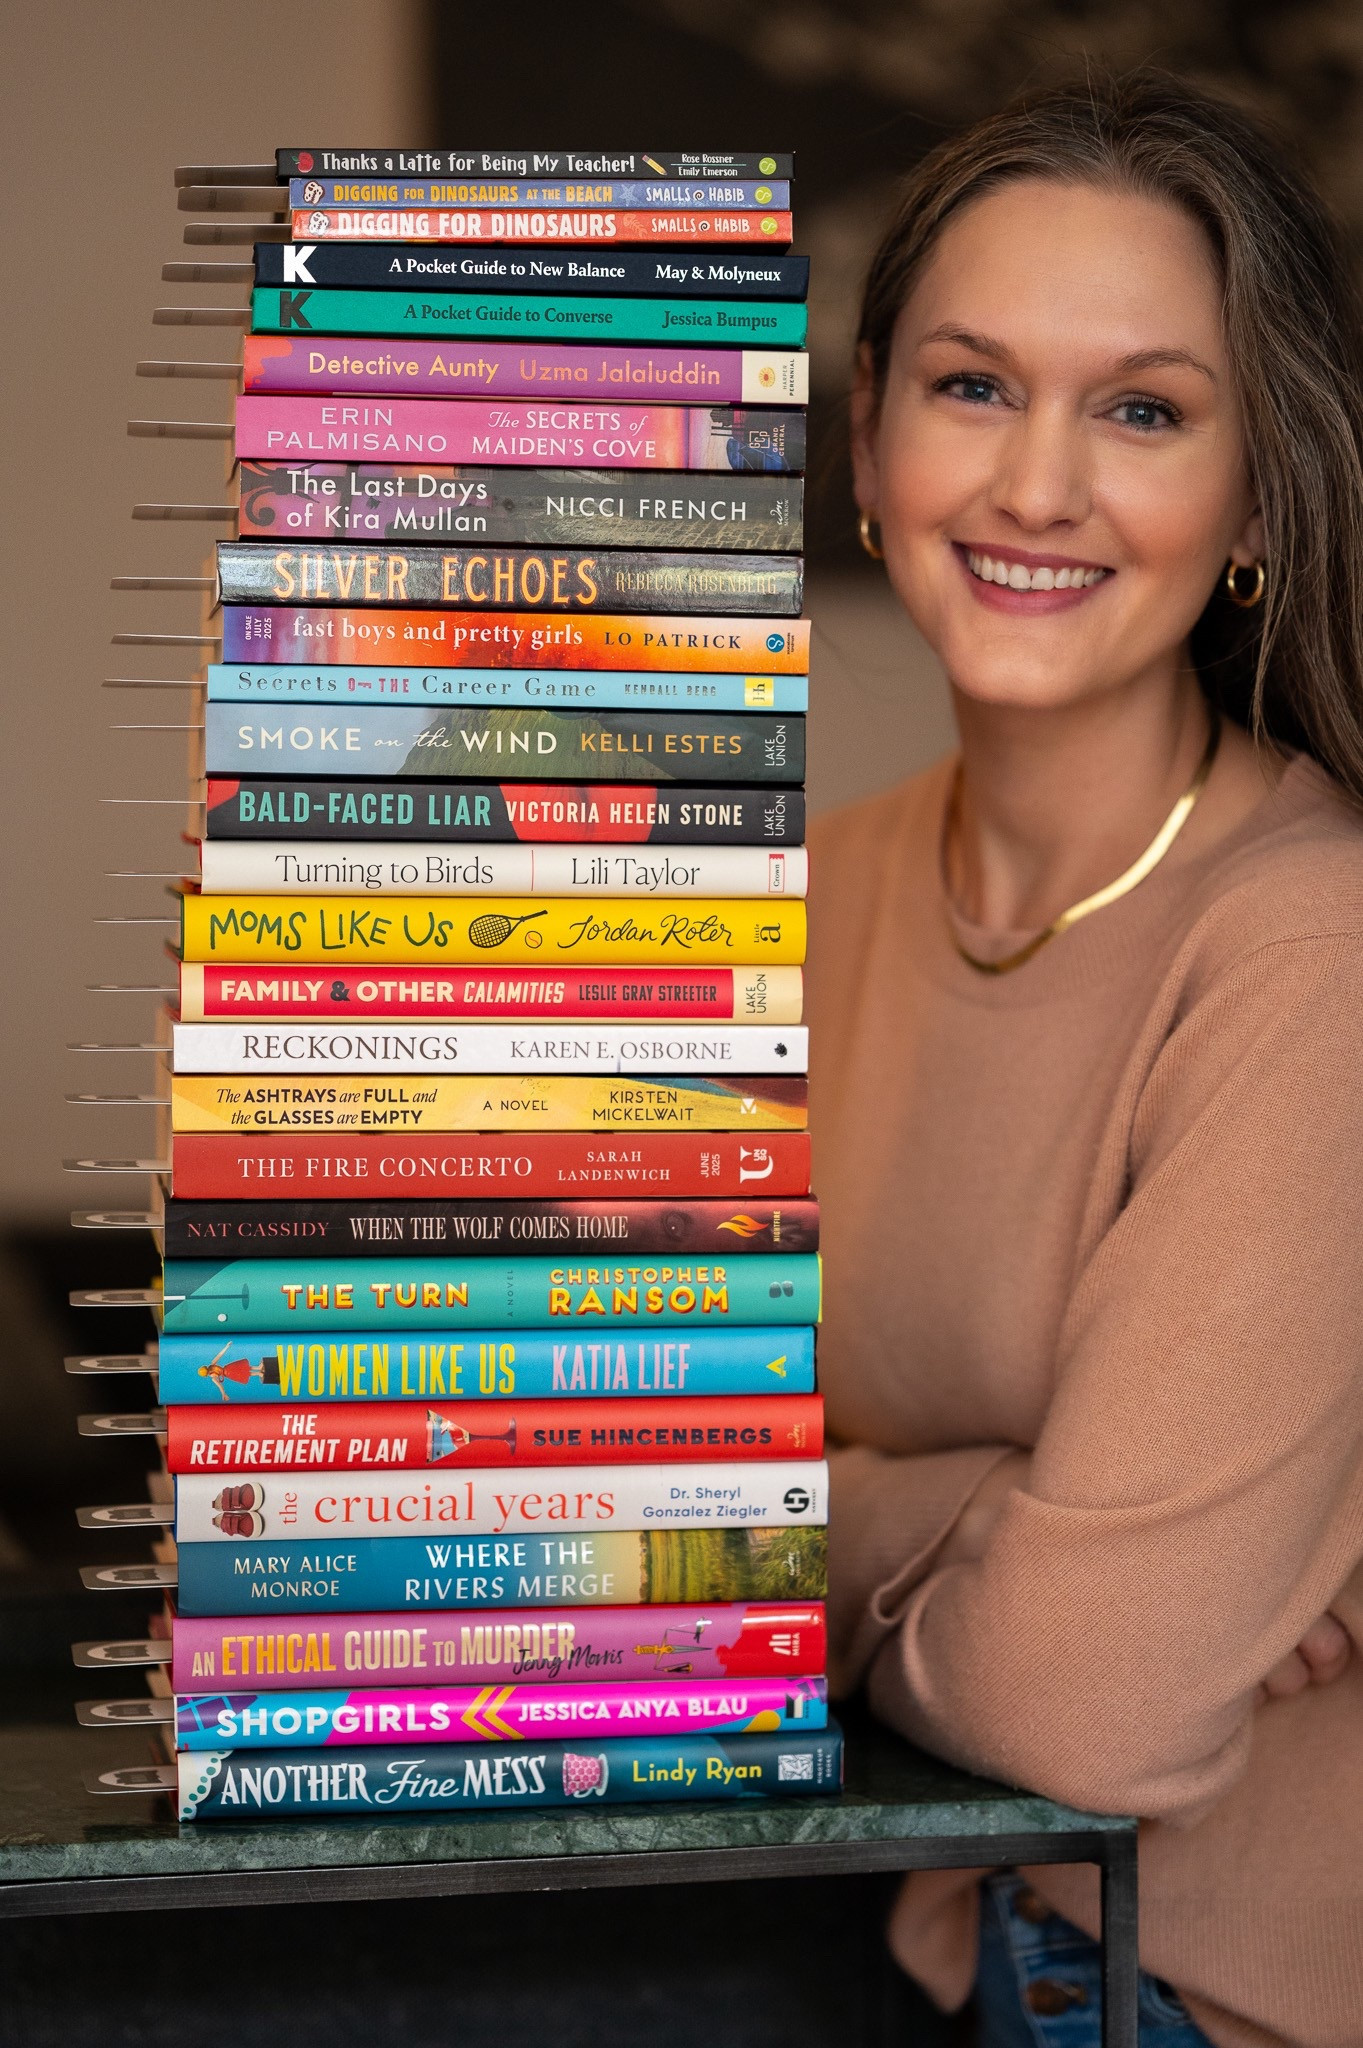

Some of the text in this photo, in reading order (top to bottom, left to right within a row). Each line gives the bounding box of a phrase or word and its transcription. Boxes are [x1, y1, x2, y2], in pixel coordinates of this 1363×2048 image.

[322, 152, 635, 175] Thanks a Latte for Being My Teacher!
[681, 154, 734, 164] Rose Rossner
[678, 167, 738, 177] Emily Emerson
[334, 185, 612, 202] DIGGING FOR DINOSAURS AT THE BEACH
[646, 186, 744, 202] SMALLS HABIB
[283, 245, 317, 283] K
[389, 258, 626, 278] A Pocket Guide to New Balance
[655, 264, 782, 284] May & Molyneux
[309, 352, 500, 384] Detective Aunty
[520, 359, 720, 385] Uzma Jalaluddin
[321, 407, 393, 426] ERIN
[488, 410, 649, 436] The SECRETS of
[267, 430, 447, 453] PALMISANO
[471, 436, 656, 459] MAIDEN'S COVE
[287, 470, 488, 506] The Last Days
[287, 503, 487, 532] of Kira Mullan
[546, 496, 747, 522] NICCI FRENCH
[273, 552, 598, 606] SILVER ECHOES
[616, 571, 777, 595] REBECCA ROSENBERG
[254, 618, 262, 638] JULY
[264, 617, 272, 640] 2025
[605, 631, 741, 650] LO PATRICK
[238, 672, 596, 697] Secrets THE Career Game
[625, 683, 717, 697] KENDALL BERG
[239, 726, 557, 754] SMOKE on the WIND
[581, 733, 742, 754] KELLI ESTES
[765, 738, 775, 766] LAKE
[776, 725, 786, 766] UNION
[239, 791, 491, 826] BALD-FACED LIAR
[505, 801, 743, 826] VICTORIA HELEN STONE
[572, 858, 700, 891] Lili Taylor
[210, 909, 453, 950] MOMS LIKE US
[557, 914, 734, 948] Jordan Roter
[760, 922, 781, 943] a
[221, 980, 565, 1004] FAMILY & OTHER CALAMITIES
[579, 984, 717, 1002] LESLIE GRAY STREETER
[242, 1035, 458, 1060] RECKONINGS
[510, 1041, 732, 1060] KAREN E. OSBORNE
[610, 1091, 677, 1104] KIRSTEN
[593, 1108, 694, 1121] MICKELWAIT
[237, 1157, 532, 1178] THE FIRE CONCERTO
[587, 1151, 642, 1162] SARAH
[700, 1152, 709, 1178] JUNE
[712, 1153, 720, 1176] 2025
[558, 1169, 670, 1181] LANDENWICH
[187, 1222, 329, 1238] NAT CASSIDY
[773, 1210, 781, 1242] NIGHTFIRE
[550, 1267, 726, 1285] CHRISTOPHER
[281, 1282, 469, 1309] THE TURN
[549, 1285, 729, 1316] RANSOM
[552, 1343, 690, 1390] KATIA LIEF
[282, 1414, 317, 1436] THE
[533, 1428, 772, 1447] SUE HINCENBERGS
[190, 1438, 408, 1465] RETIREMENT PLAN
[670, 1487, 741, 1501] Dr. Sheryl
[279, 1482, 615, 1533] the crucial years
[643, 1505, 767, 1519] Gonzalez Ziegler
[234, 1555, 357, 1575] MARY ALICE
[425, 1541, 594, 1568] WHERE THE
[251, 1580, 340, 1598] MONROE
[405, 1573, 615, 1601] RIVERS MERGE
[792, 1633, 800, 1657] MIRA
[513, 1645, 625, 1678] Jenny Morris
[216, 1703, 451, 1738] SHOPGIRLS
[518, 1698, 748, 1722] JESSICA ANYA BLAU
[221, 1755, 546, 1808] ANOTHER Fine MESS
[632, 1754, 762, 1786] Lindy Ryan
